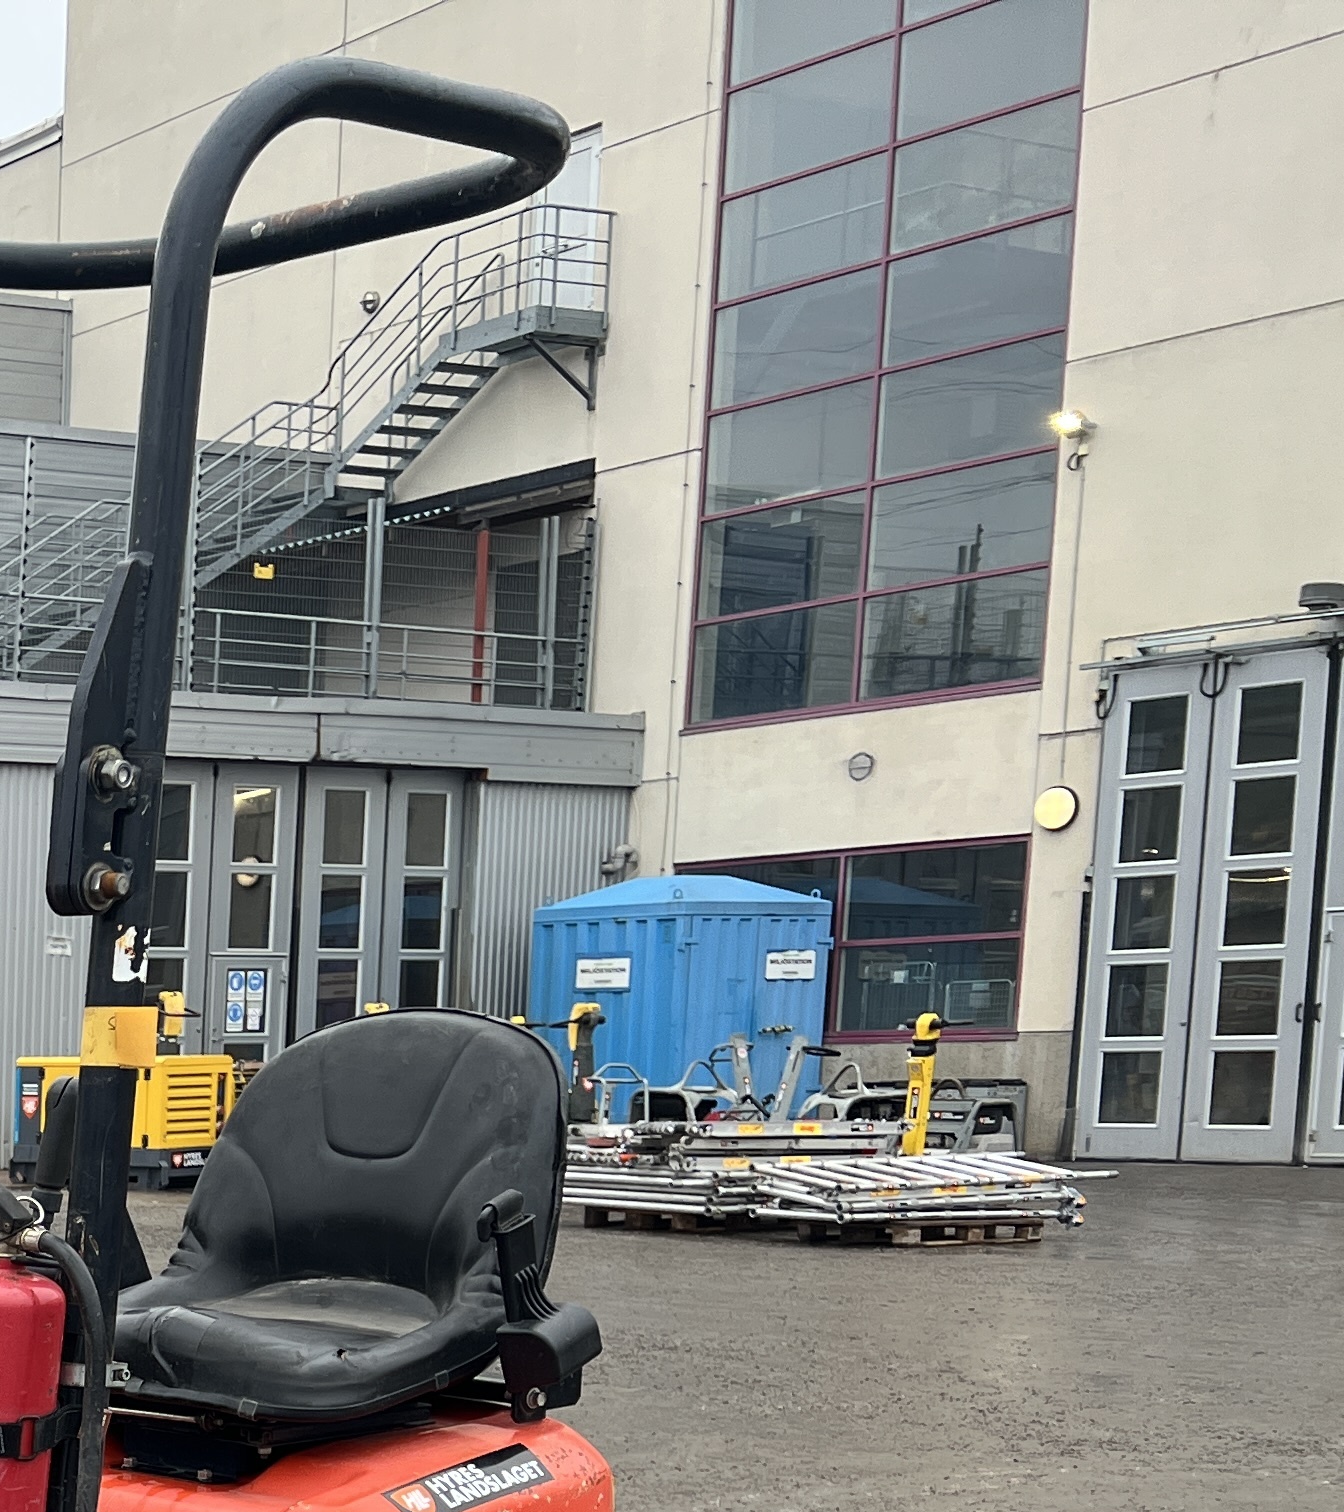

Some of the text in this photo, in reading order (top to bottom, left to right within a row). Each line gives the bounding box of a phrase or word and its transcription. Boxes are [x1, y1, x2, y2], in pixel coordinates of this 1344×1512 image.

[425, 1463, 485, 1495] HYRES
[438, 1460, 545, 1509] LANDSLAGET
[401, 1489, 432, 1512] HLL
